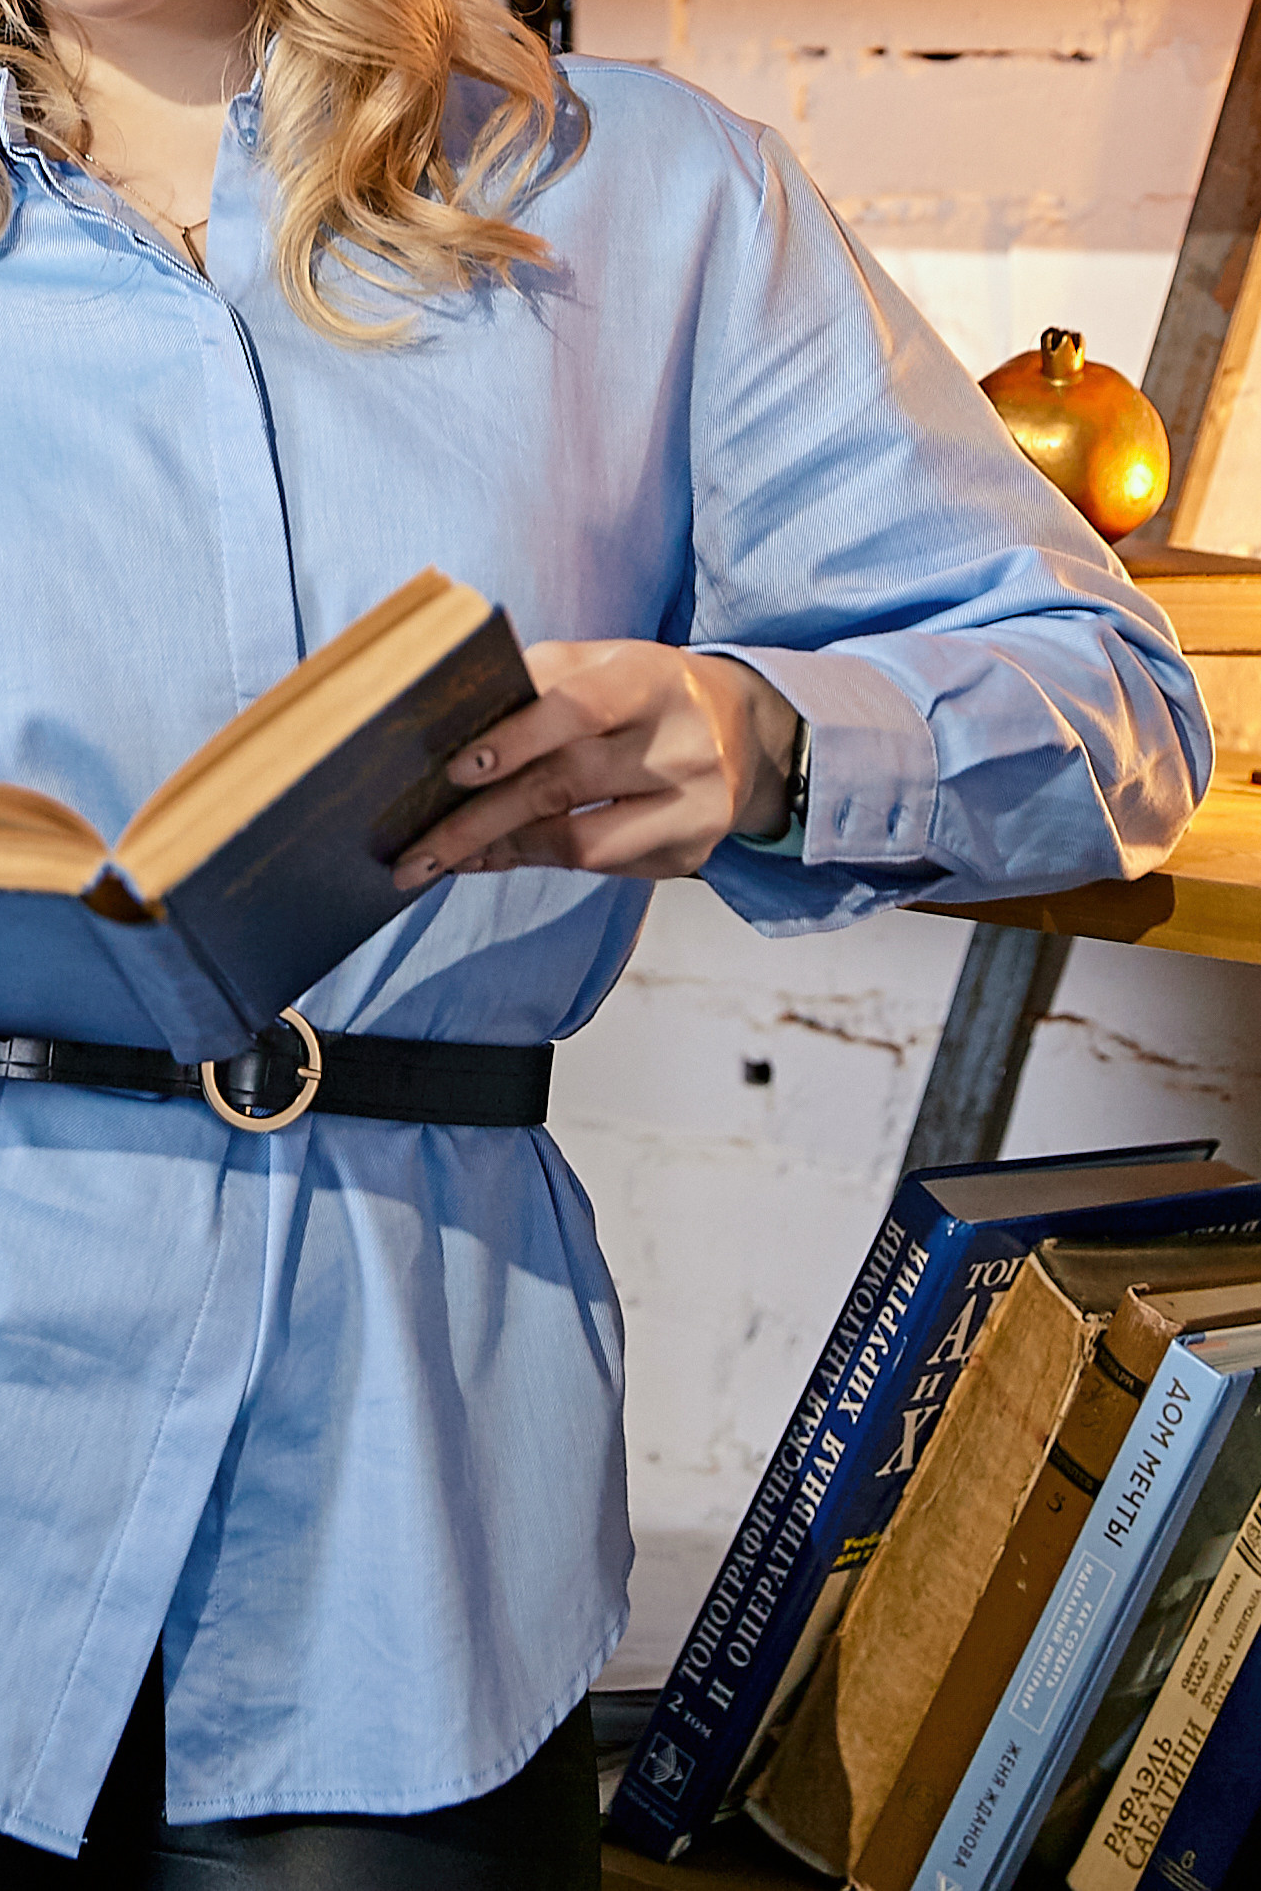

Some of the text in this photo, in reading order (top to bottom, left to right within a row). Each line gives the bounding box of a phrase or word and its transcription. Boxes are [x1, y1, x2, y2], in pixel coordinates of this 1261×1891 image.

[679, 1216, 906, 1685] ТОПОГРАФИЧЕСКАЯ АНАТОМИЯ
[707, 1239, 930, 1711] И ОПЕРАТИВНАЯ ХИРУРГИЯ
[1150, 1376, 1192, 1450] ДОМ
[1103, 1448, 1162, 1549] МЕЧТЫ
[1020, 1561, 1094, 1711] ИДЕАЛЬНЫЙ ИНТЕРЬЕР
[1045, 1599, 1093, 1689] КАК СОЗДАТЬ
[666, 1691, 685, 1713] 2
[953, 1738, 1023, 1869] ЖЕНЯ ЖДАНОВА
[1102, 1735, 1173, 1858] РАФАЭЛЬ
[1123, 1714, 1208, 1871] САБАТИНИ
